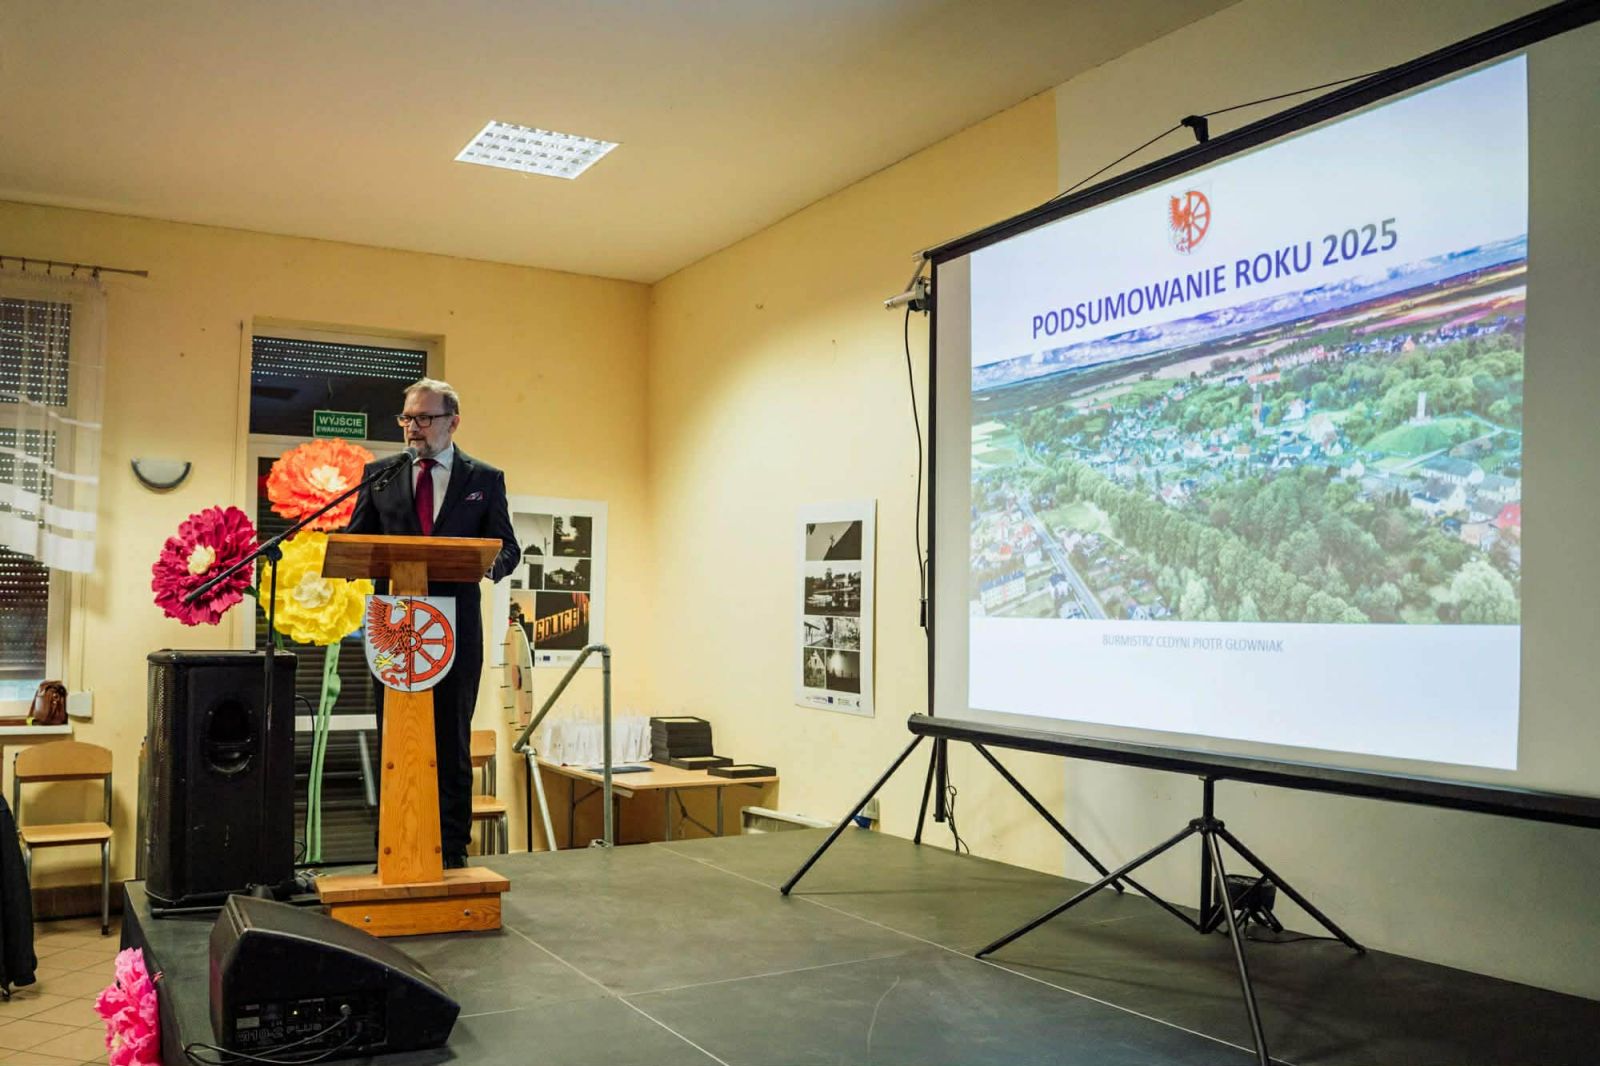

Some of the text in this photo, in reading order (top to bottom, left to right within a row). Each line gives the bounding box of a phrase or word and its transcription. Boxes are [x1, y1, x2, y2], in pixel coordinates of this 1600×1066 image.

[1033, 217, 1399, 339] PODSUMOWANIE ROKU 2025
[319, 416, 362, 427] WYJŚCIE
[1102, 634, 1153, 647] BURMISTRZ
[1156, 636, 1191, 649] CEDYNI
[1193, 637, 1222, 650] PIOTR
